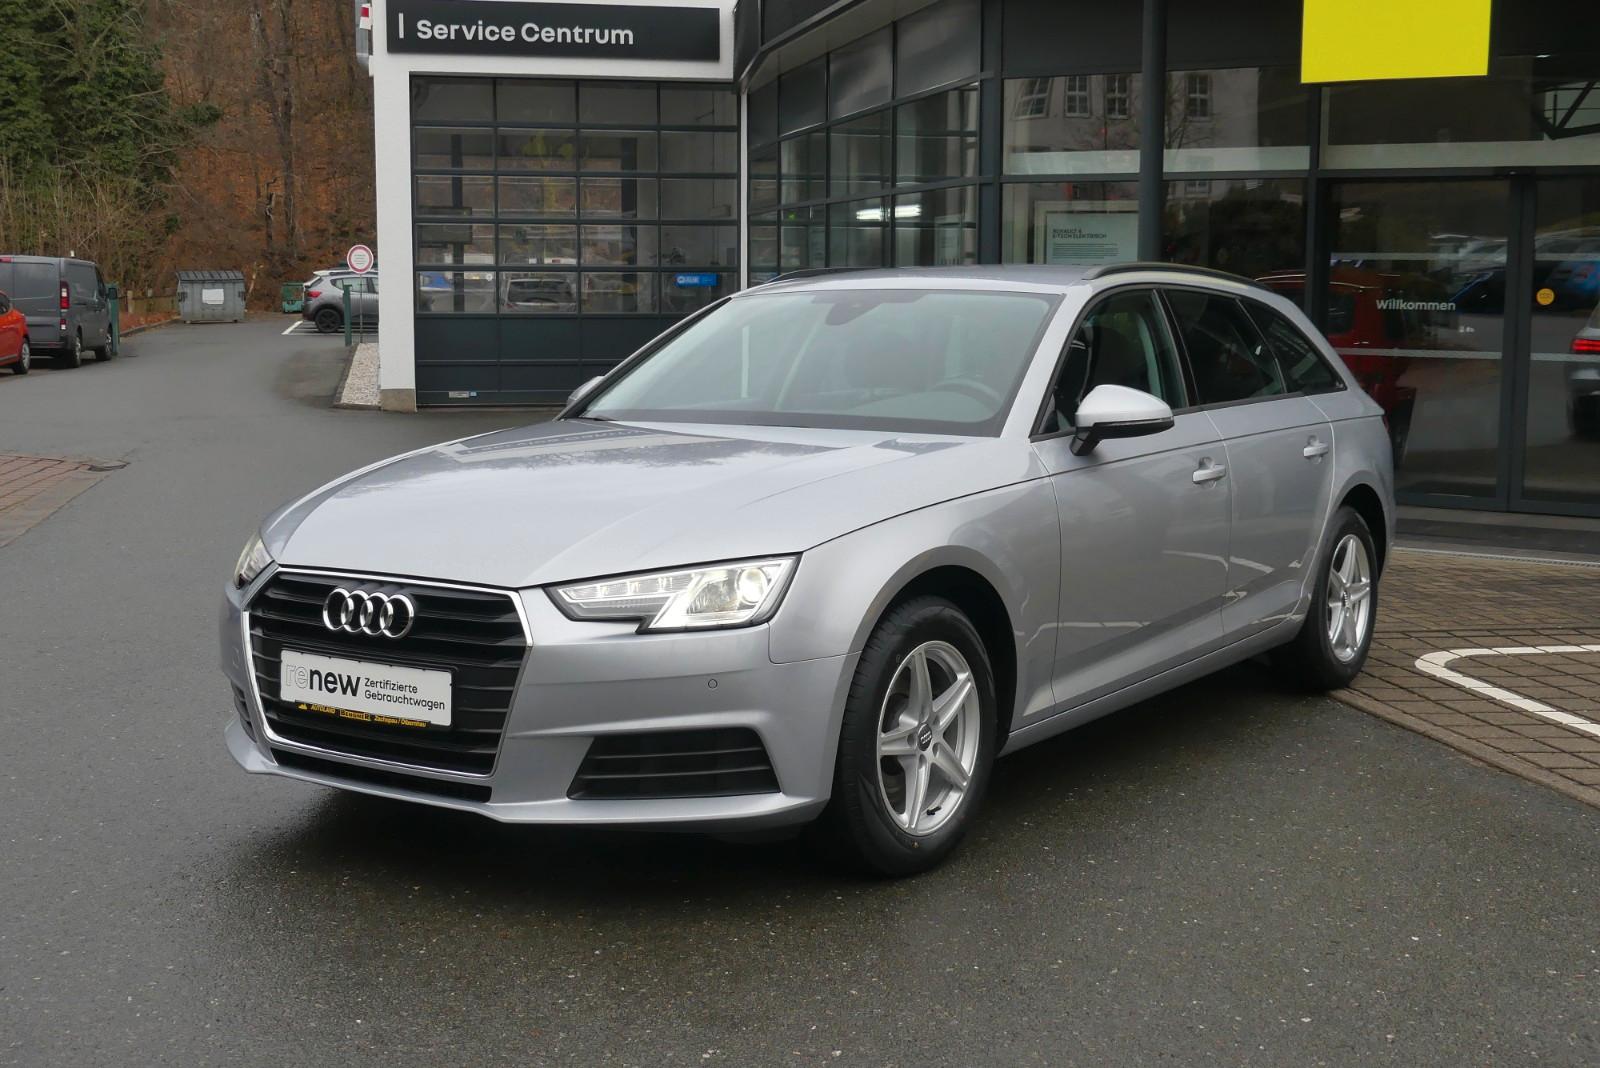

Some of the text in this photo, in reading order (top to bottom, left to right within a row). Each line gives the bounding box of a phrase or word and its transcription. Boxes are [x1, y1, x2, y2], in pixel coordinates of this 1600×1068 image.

[416, 20, 634, 45] Service Centrum
[1376, 298, 1456, 311] Willkommen
[286, 664, 361, 697] renew
[364, 677, 418, 694] Zertifizierte
[364, 689, 446, 711] Gebrauchtwagen
